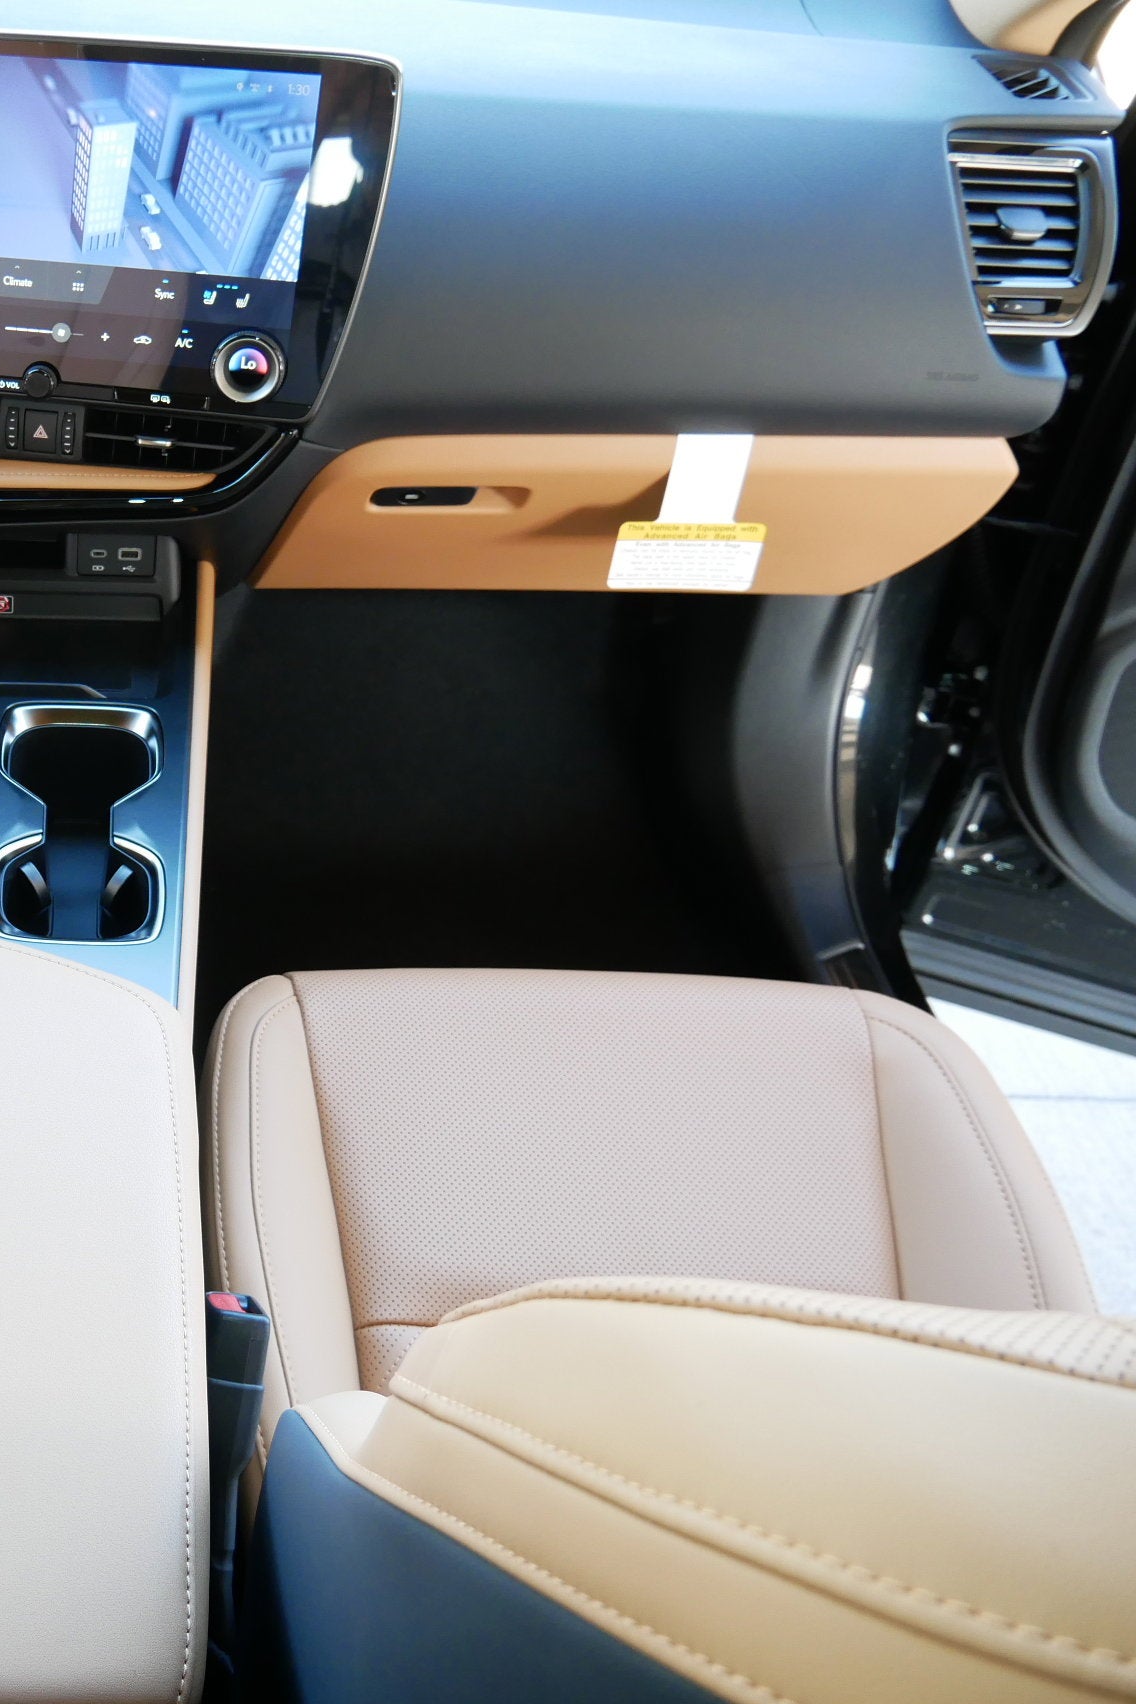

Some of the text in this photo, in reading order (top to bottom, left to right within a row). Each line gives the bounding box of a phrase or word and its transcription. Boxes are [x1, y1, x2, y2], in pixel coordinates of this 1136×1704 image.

[288, 83, 310, 96] 1:30
[3, 276, 33, 288] Climate
[155, 288, 175, 300] Sync
[175, 338, 193, 349] A/C
[241, 356, 256, 370] Lo
[5, 381, 20, 389] VOL
